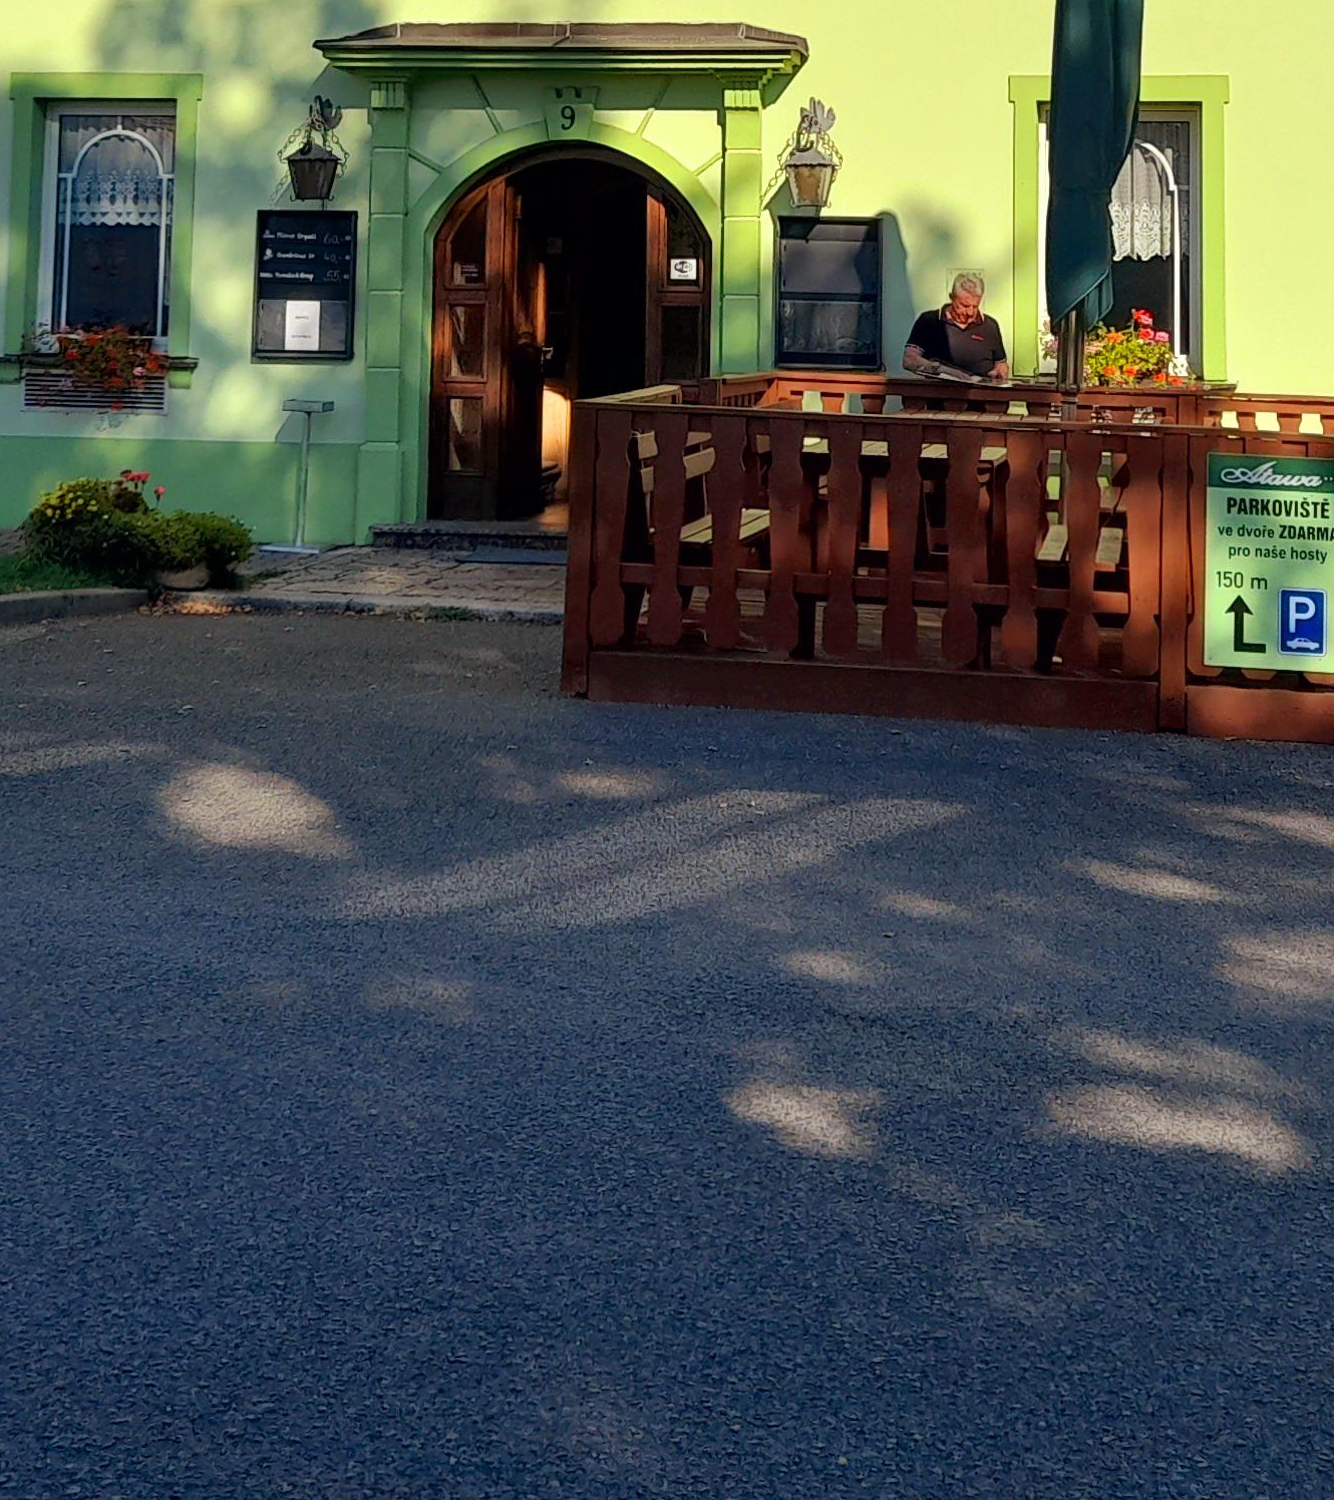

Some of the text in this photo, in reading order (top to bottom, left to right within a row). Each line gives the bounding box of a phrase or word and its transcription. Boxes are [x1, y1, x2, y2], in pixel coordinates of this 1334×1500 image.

[560, 105, 576, 130] 9
[1220, 461, 1323, 487] Atawa
[1227, 497, 1331, 519] PARKOVIŠTĚ
[1218, 525, 1233, 536] ve
[1228, 545, 1328, 564] pro naše hosty
[1216, 571, 1268, 590] 150 m
[1289, 595, 1316, 634] P
